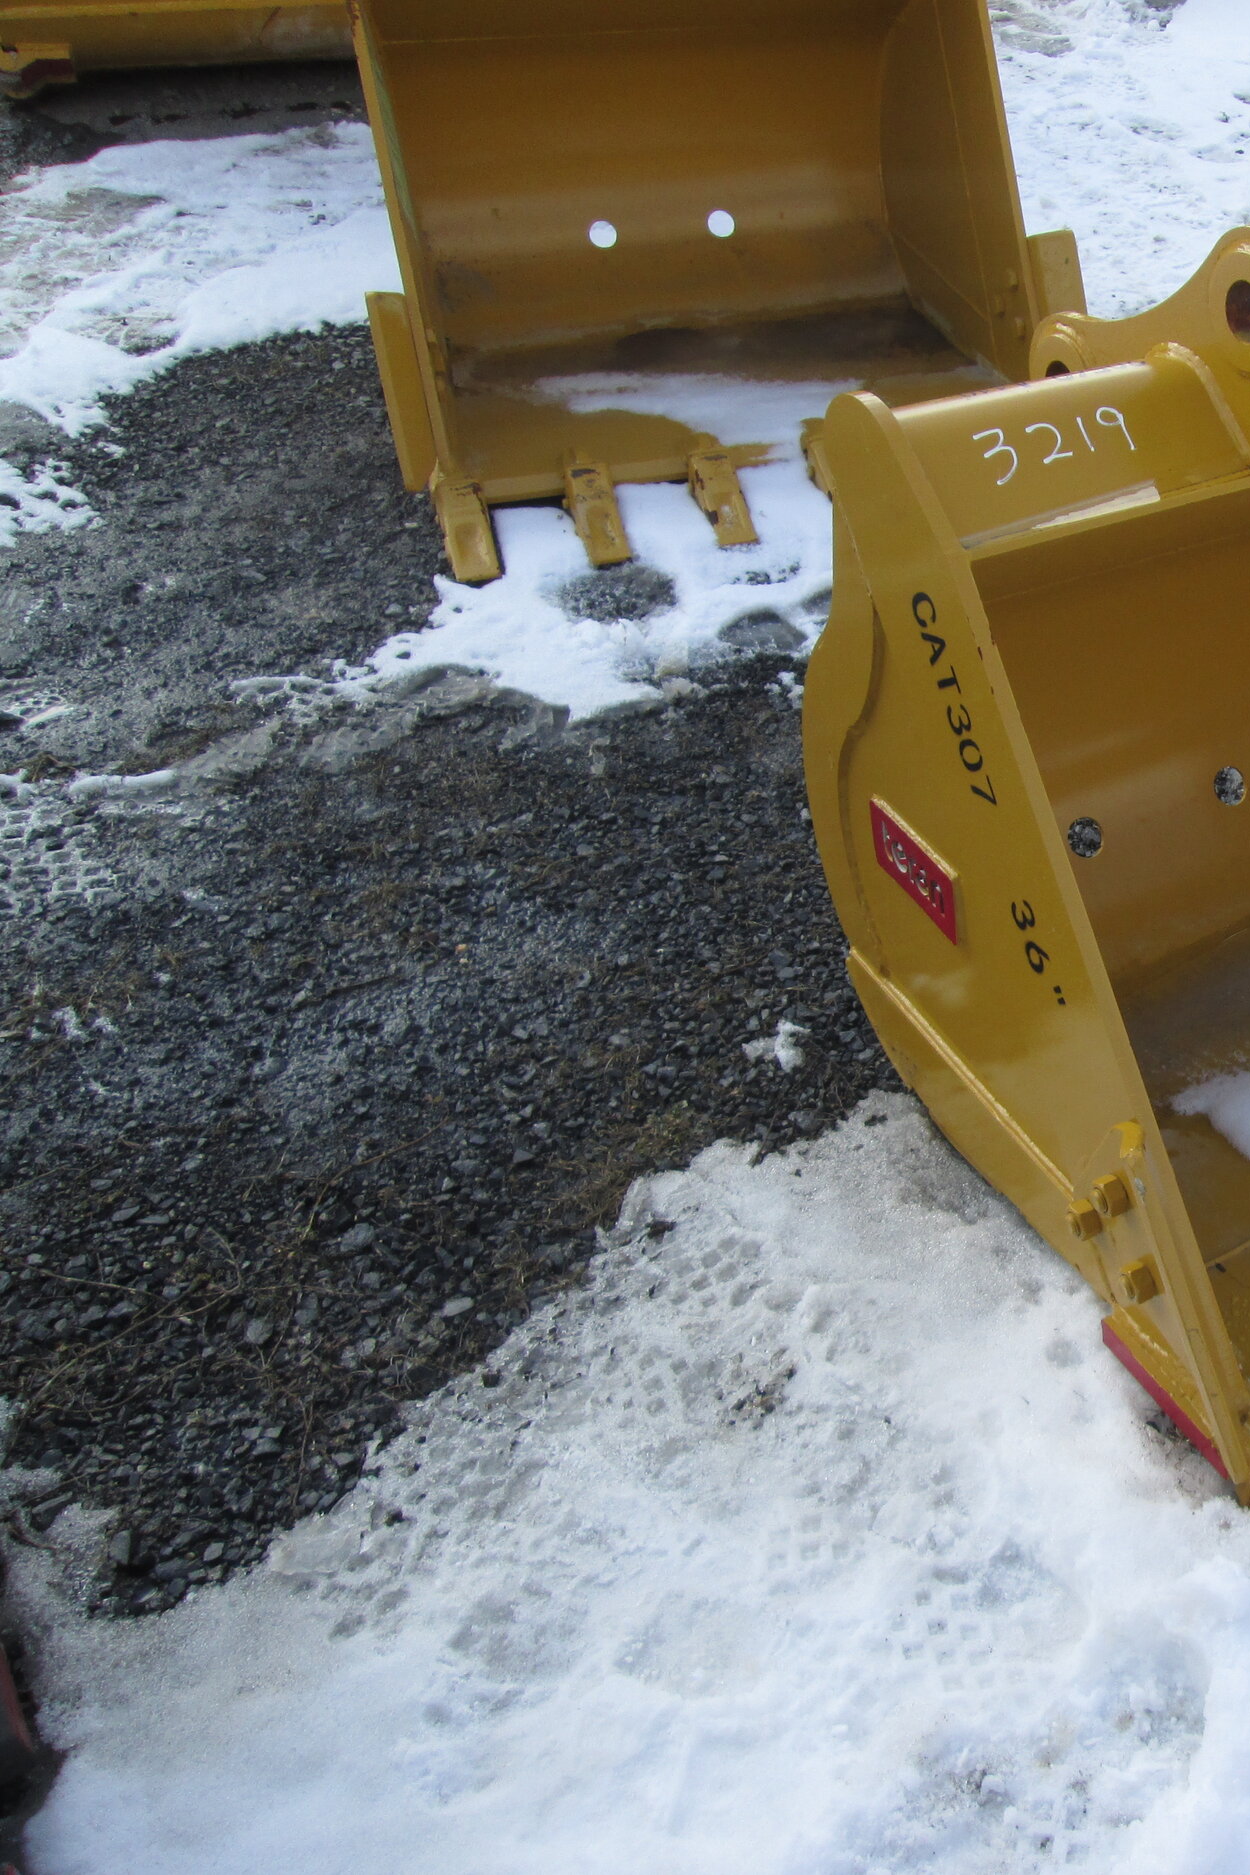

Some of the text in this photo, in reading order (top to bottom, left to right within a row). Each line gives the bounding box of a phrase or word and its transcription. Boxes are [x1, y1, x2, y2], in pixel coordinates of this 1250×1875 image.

[973, 407, 1136, 486] 3219
[911, 591, 1066, 1006] CAT307 36"
